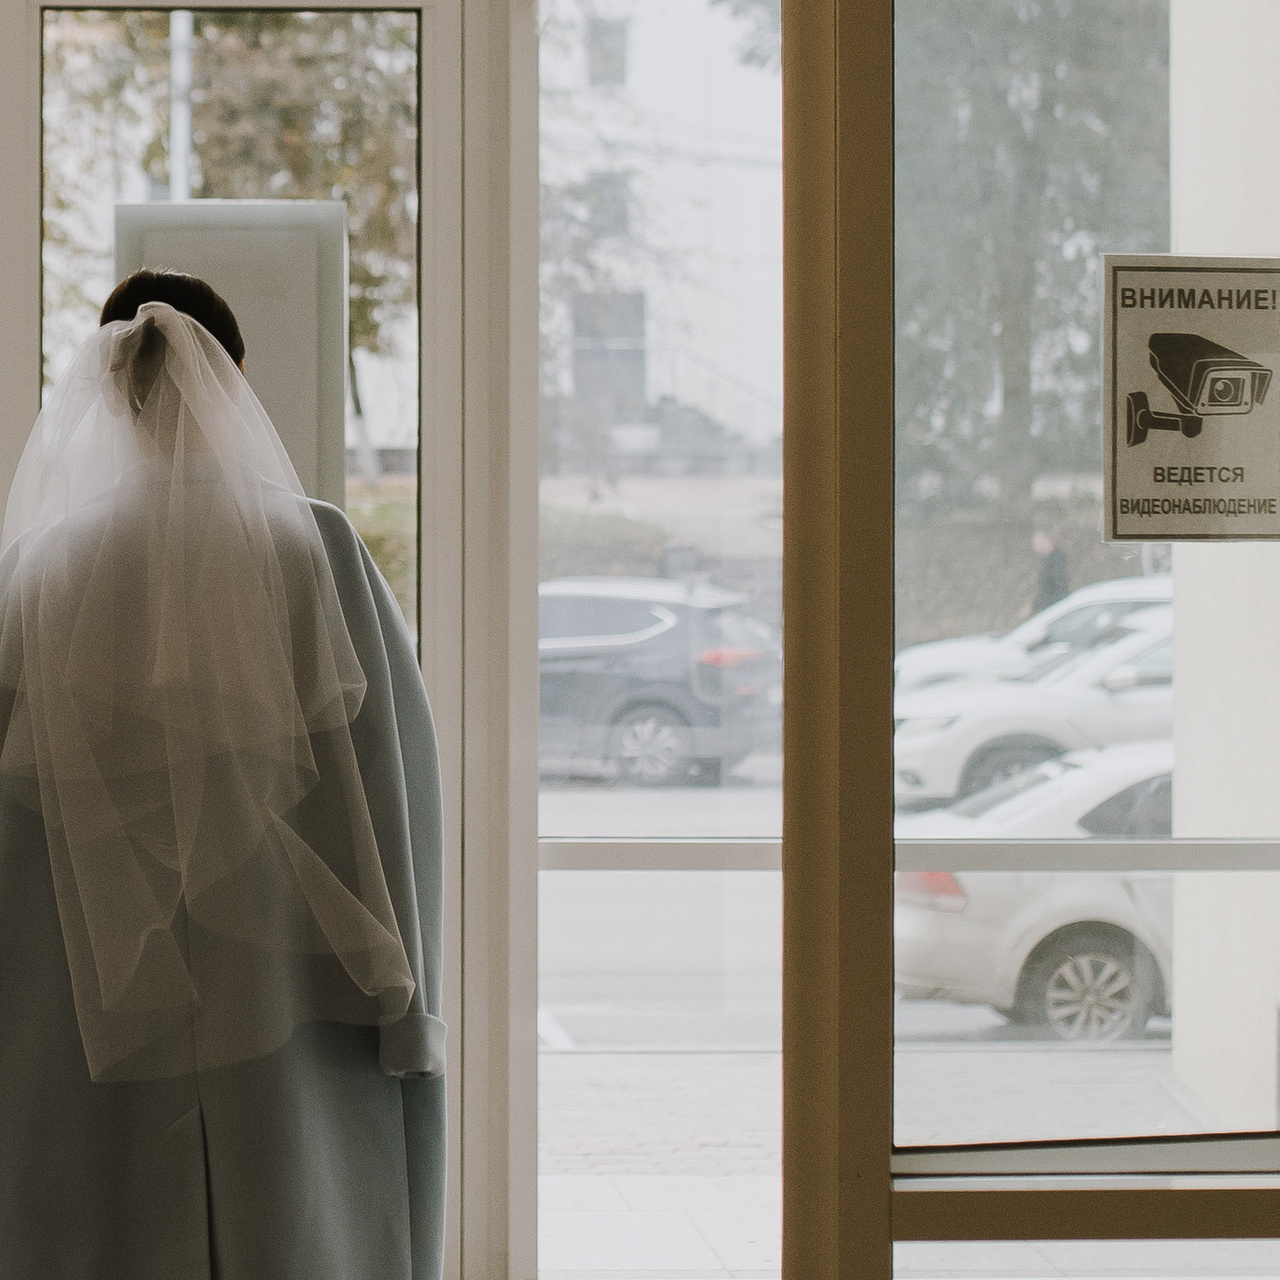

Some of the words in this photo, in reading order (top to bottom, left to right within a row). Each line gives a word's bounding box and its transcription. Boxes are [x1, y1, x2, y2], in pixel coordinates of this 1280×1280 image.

[1121, 288, 1277, 310] ВНИМАНИЕ!
[1153, 466, 1245, 486] ВЕДЕТСЯ
[1120, 498, 1276, 517] ВИДЕОНАБЛЮДЕНИЕ
